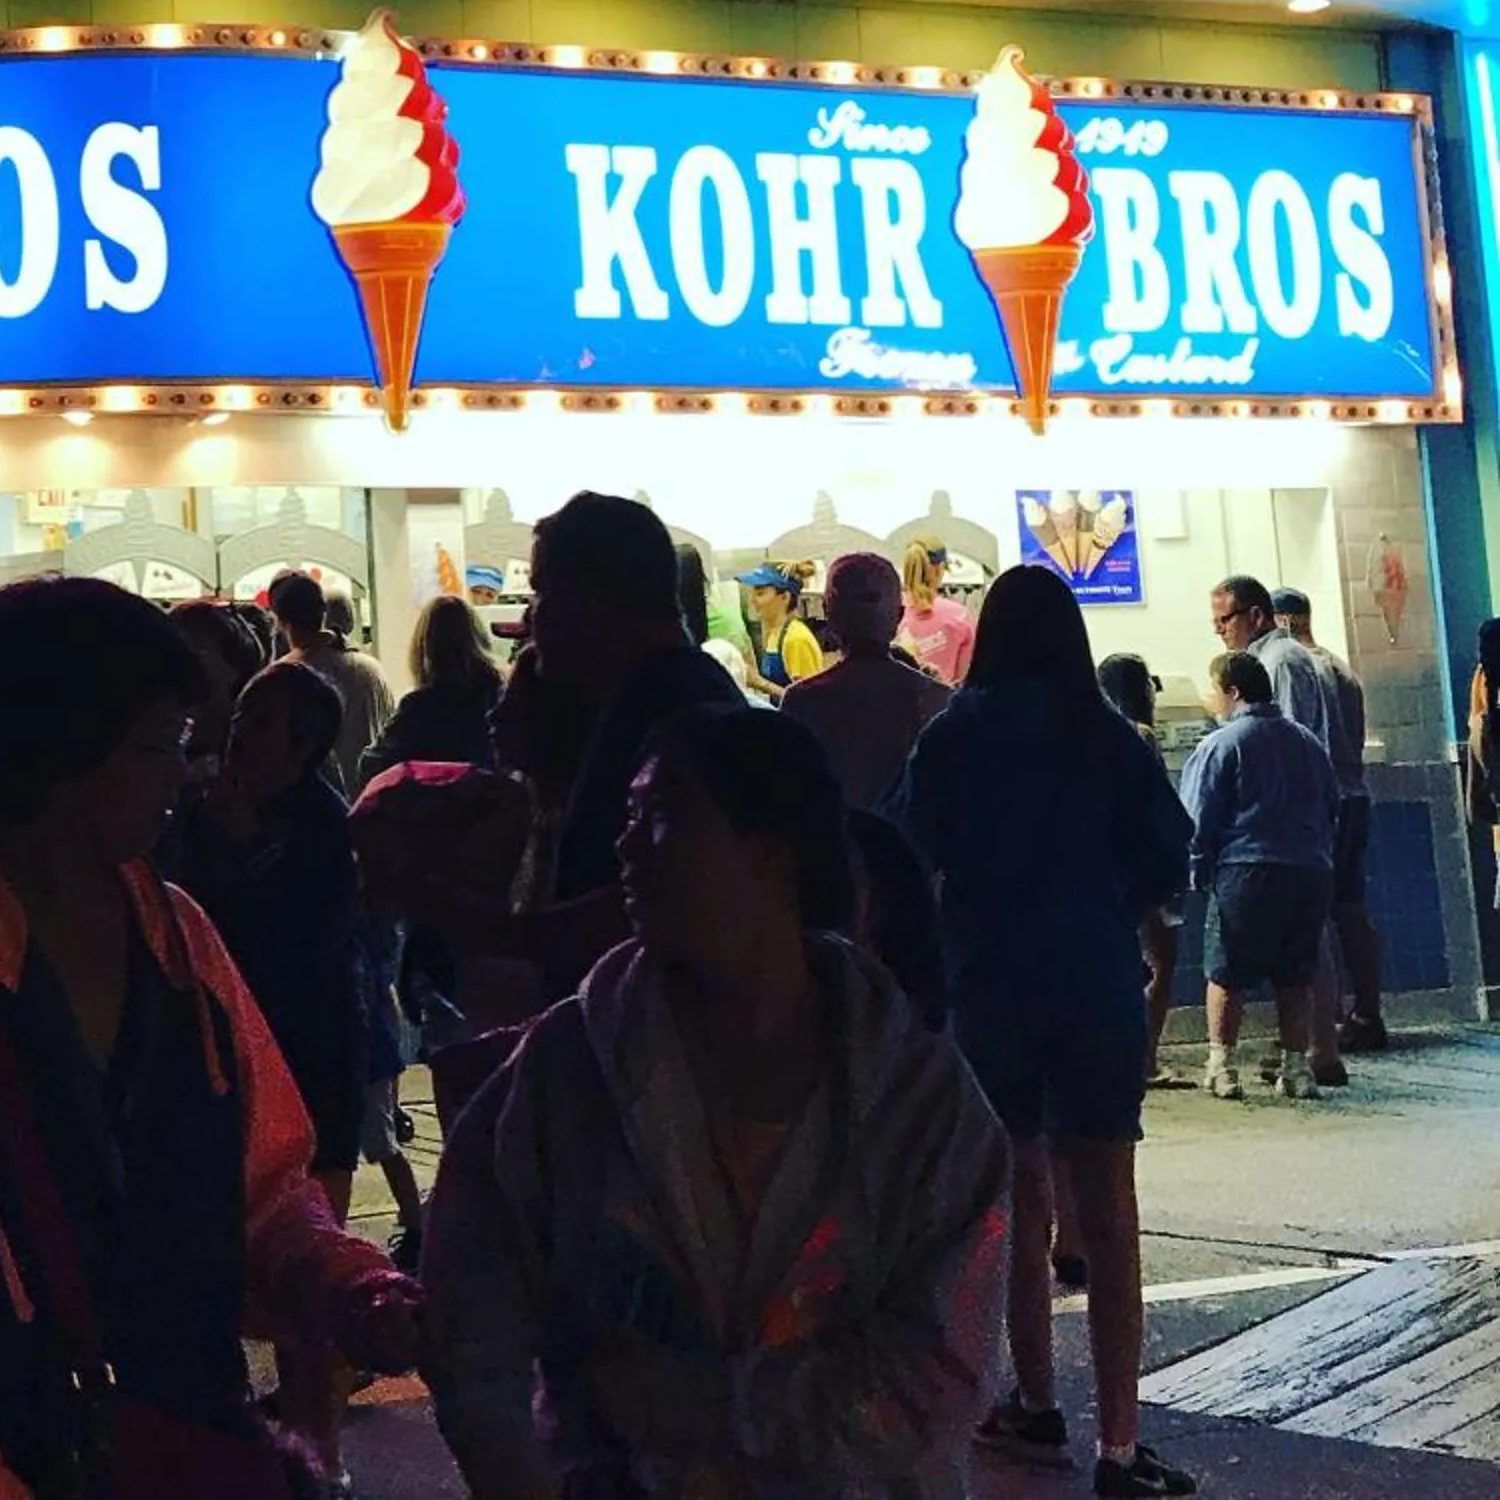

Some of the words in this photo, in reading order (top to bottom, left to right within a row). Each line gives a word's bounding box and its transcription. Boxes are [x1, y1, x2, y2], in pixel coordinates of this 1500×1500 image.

[807, 100, 932, 155] Since
[1073, 116, 1169, 157] 1919
[566, 143, 943, 328] KOHR
[1093, 169, 1394, 342] BROS
[1090, 332, 1260, 385] Custard
